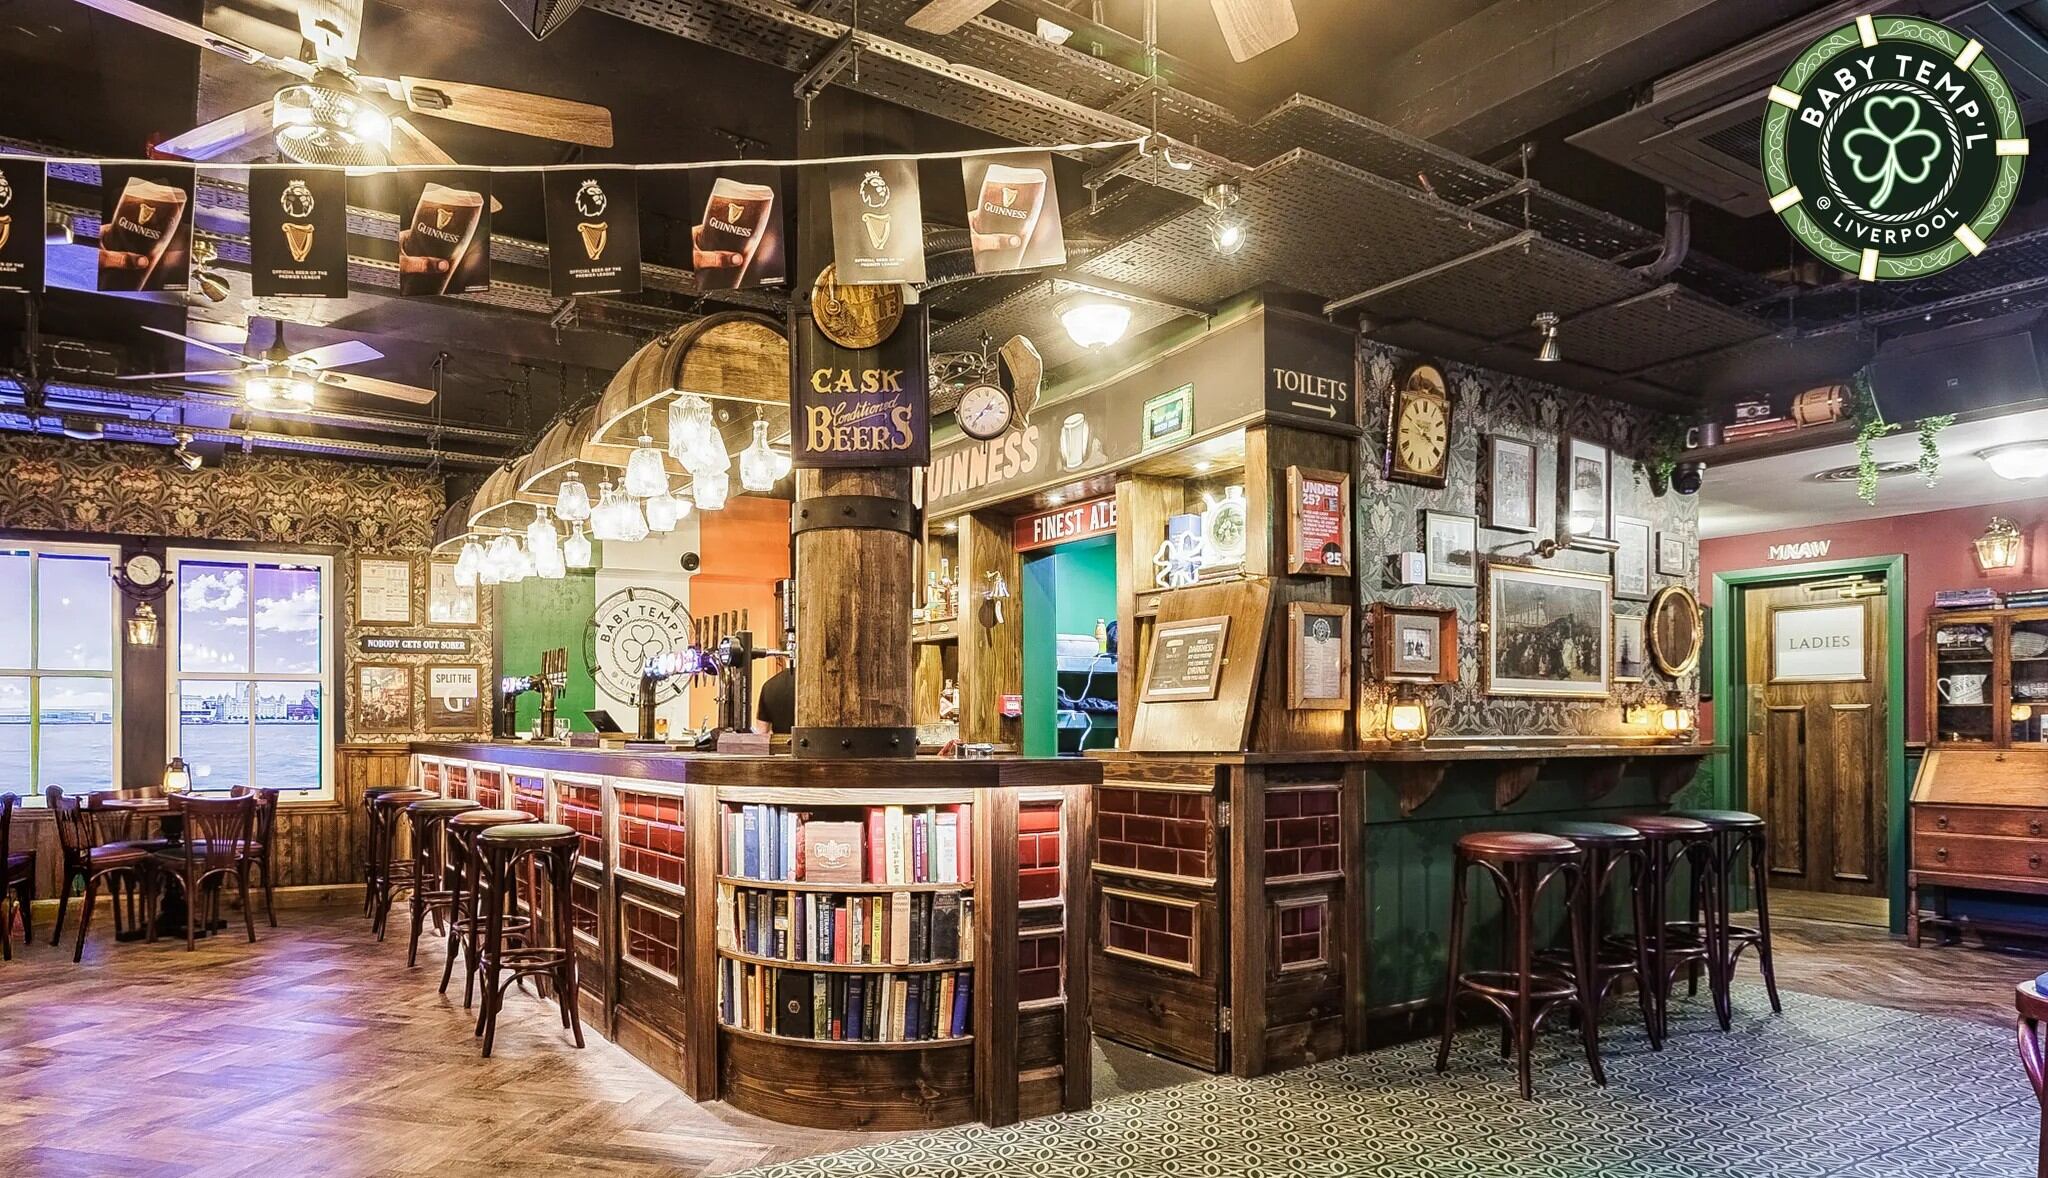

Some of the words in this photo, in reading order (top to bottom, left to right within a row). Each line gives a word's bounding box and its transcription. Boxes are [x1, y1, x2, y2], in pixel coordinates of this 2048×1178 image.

[984, 201, 1028, 220] GUINNESS
[118, 216, 161, 240] GUINNESS
[417, 221, 460, 243] GUINNESS
[710, 217, 752, 237] GUINNESS
[859, 297, 897, 328] ALE
[810, 367, 904, 394] CASK
[1273, 368, 1347, 402] TOILETS
[832, 394, 900, 427] Conditioned
[805, 403, 913, 453] BEERS
[928, 425, 1039, 502] UINNESS
[1303, 482, 1338, 497] UNDER
[1303, 493, 1320, 505] 25?
[1034, 509, 1084, 543] FINEST
[1326, 551, 1342, 565] 25
[600, 607, 631, 643] BABY
[639, 605, 683, 645] TEMP'L
[367, 640, 400, 648] NOBODY
[402, 641, 421, 649] GETS
[423, 641, 439, 649] OUT
[441, 642, 465, 650] SOBER
[1789, 635, 1850, 650] LADIES
[436, 673, 456, 684] SPLIT
[458, 673, 472, 684] THE
